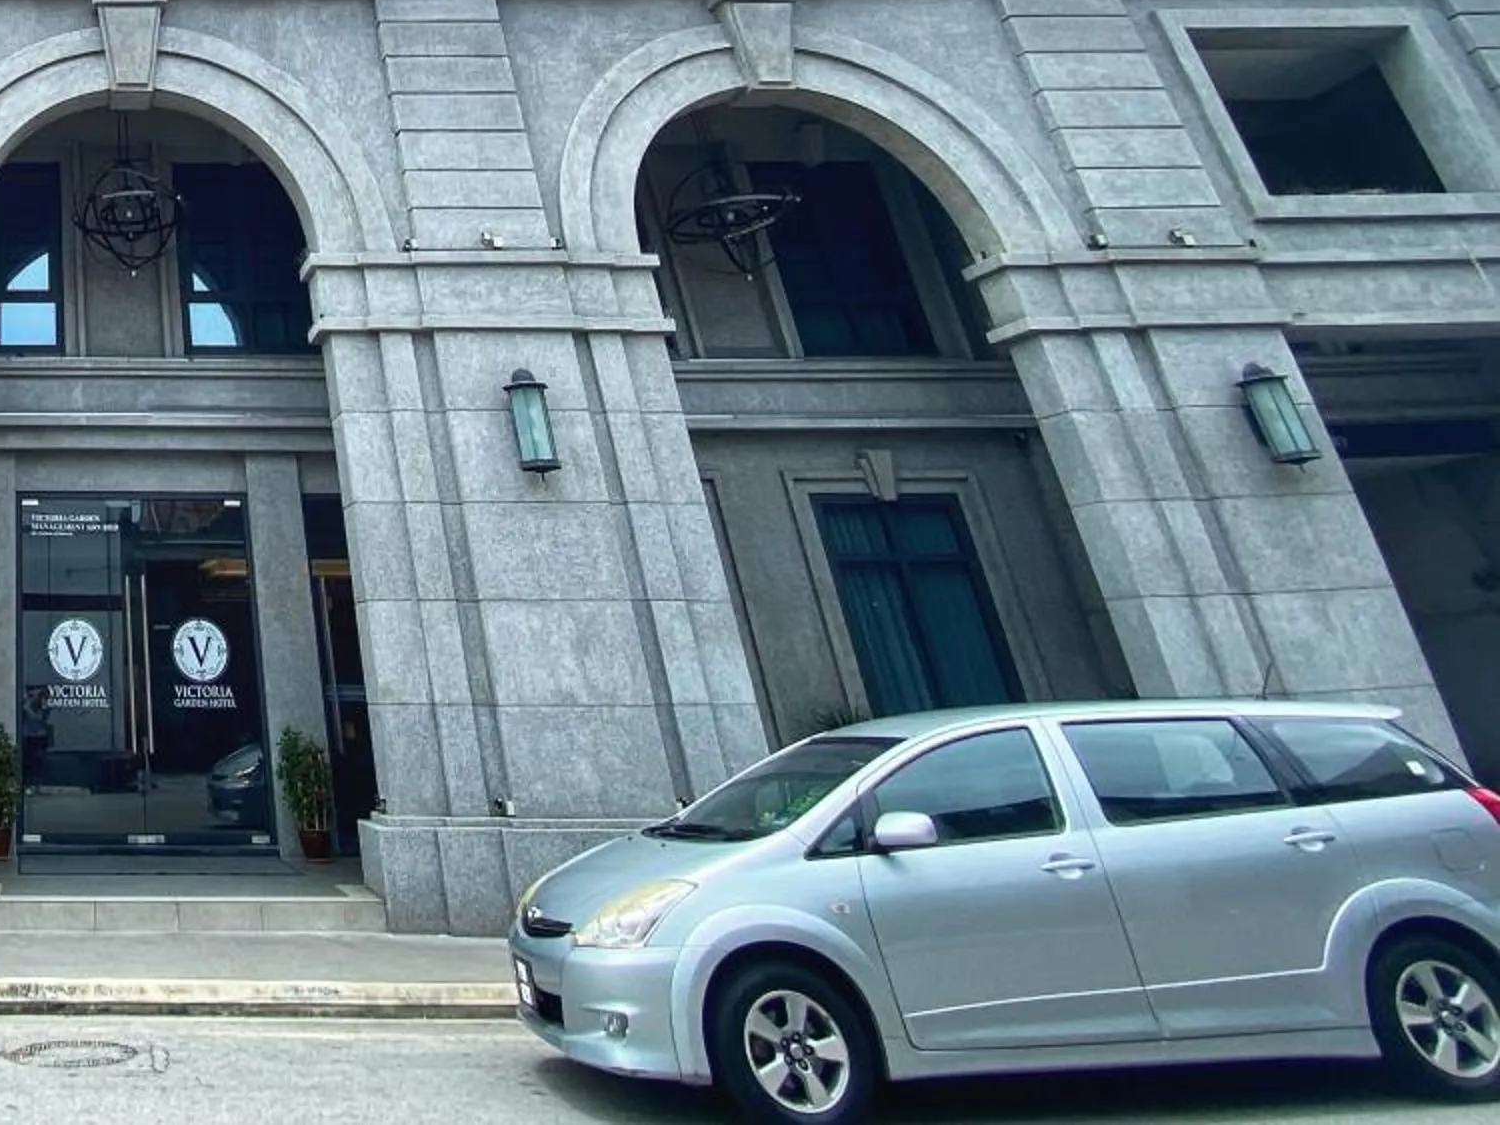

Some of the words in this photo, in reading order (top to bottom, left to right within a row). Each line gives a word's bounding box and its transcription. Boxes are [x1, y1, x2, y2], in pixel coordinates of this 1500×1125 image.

[63, 636, 88, 667] V
[187, 636, 212, 668] V
[47, 684, 106, 698] VICTORIA
[174, 684, 233, 698] VICTORIA
[47, 698, 80, 708] GARDEN
[81, 698, 109, 708] HOTEL
[173, 698, 208, 708] GARDEN
[209, 698, 236, 708] HOTEL
